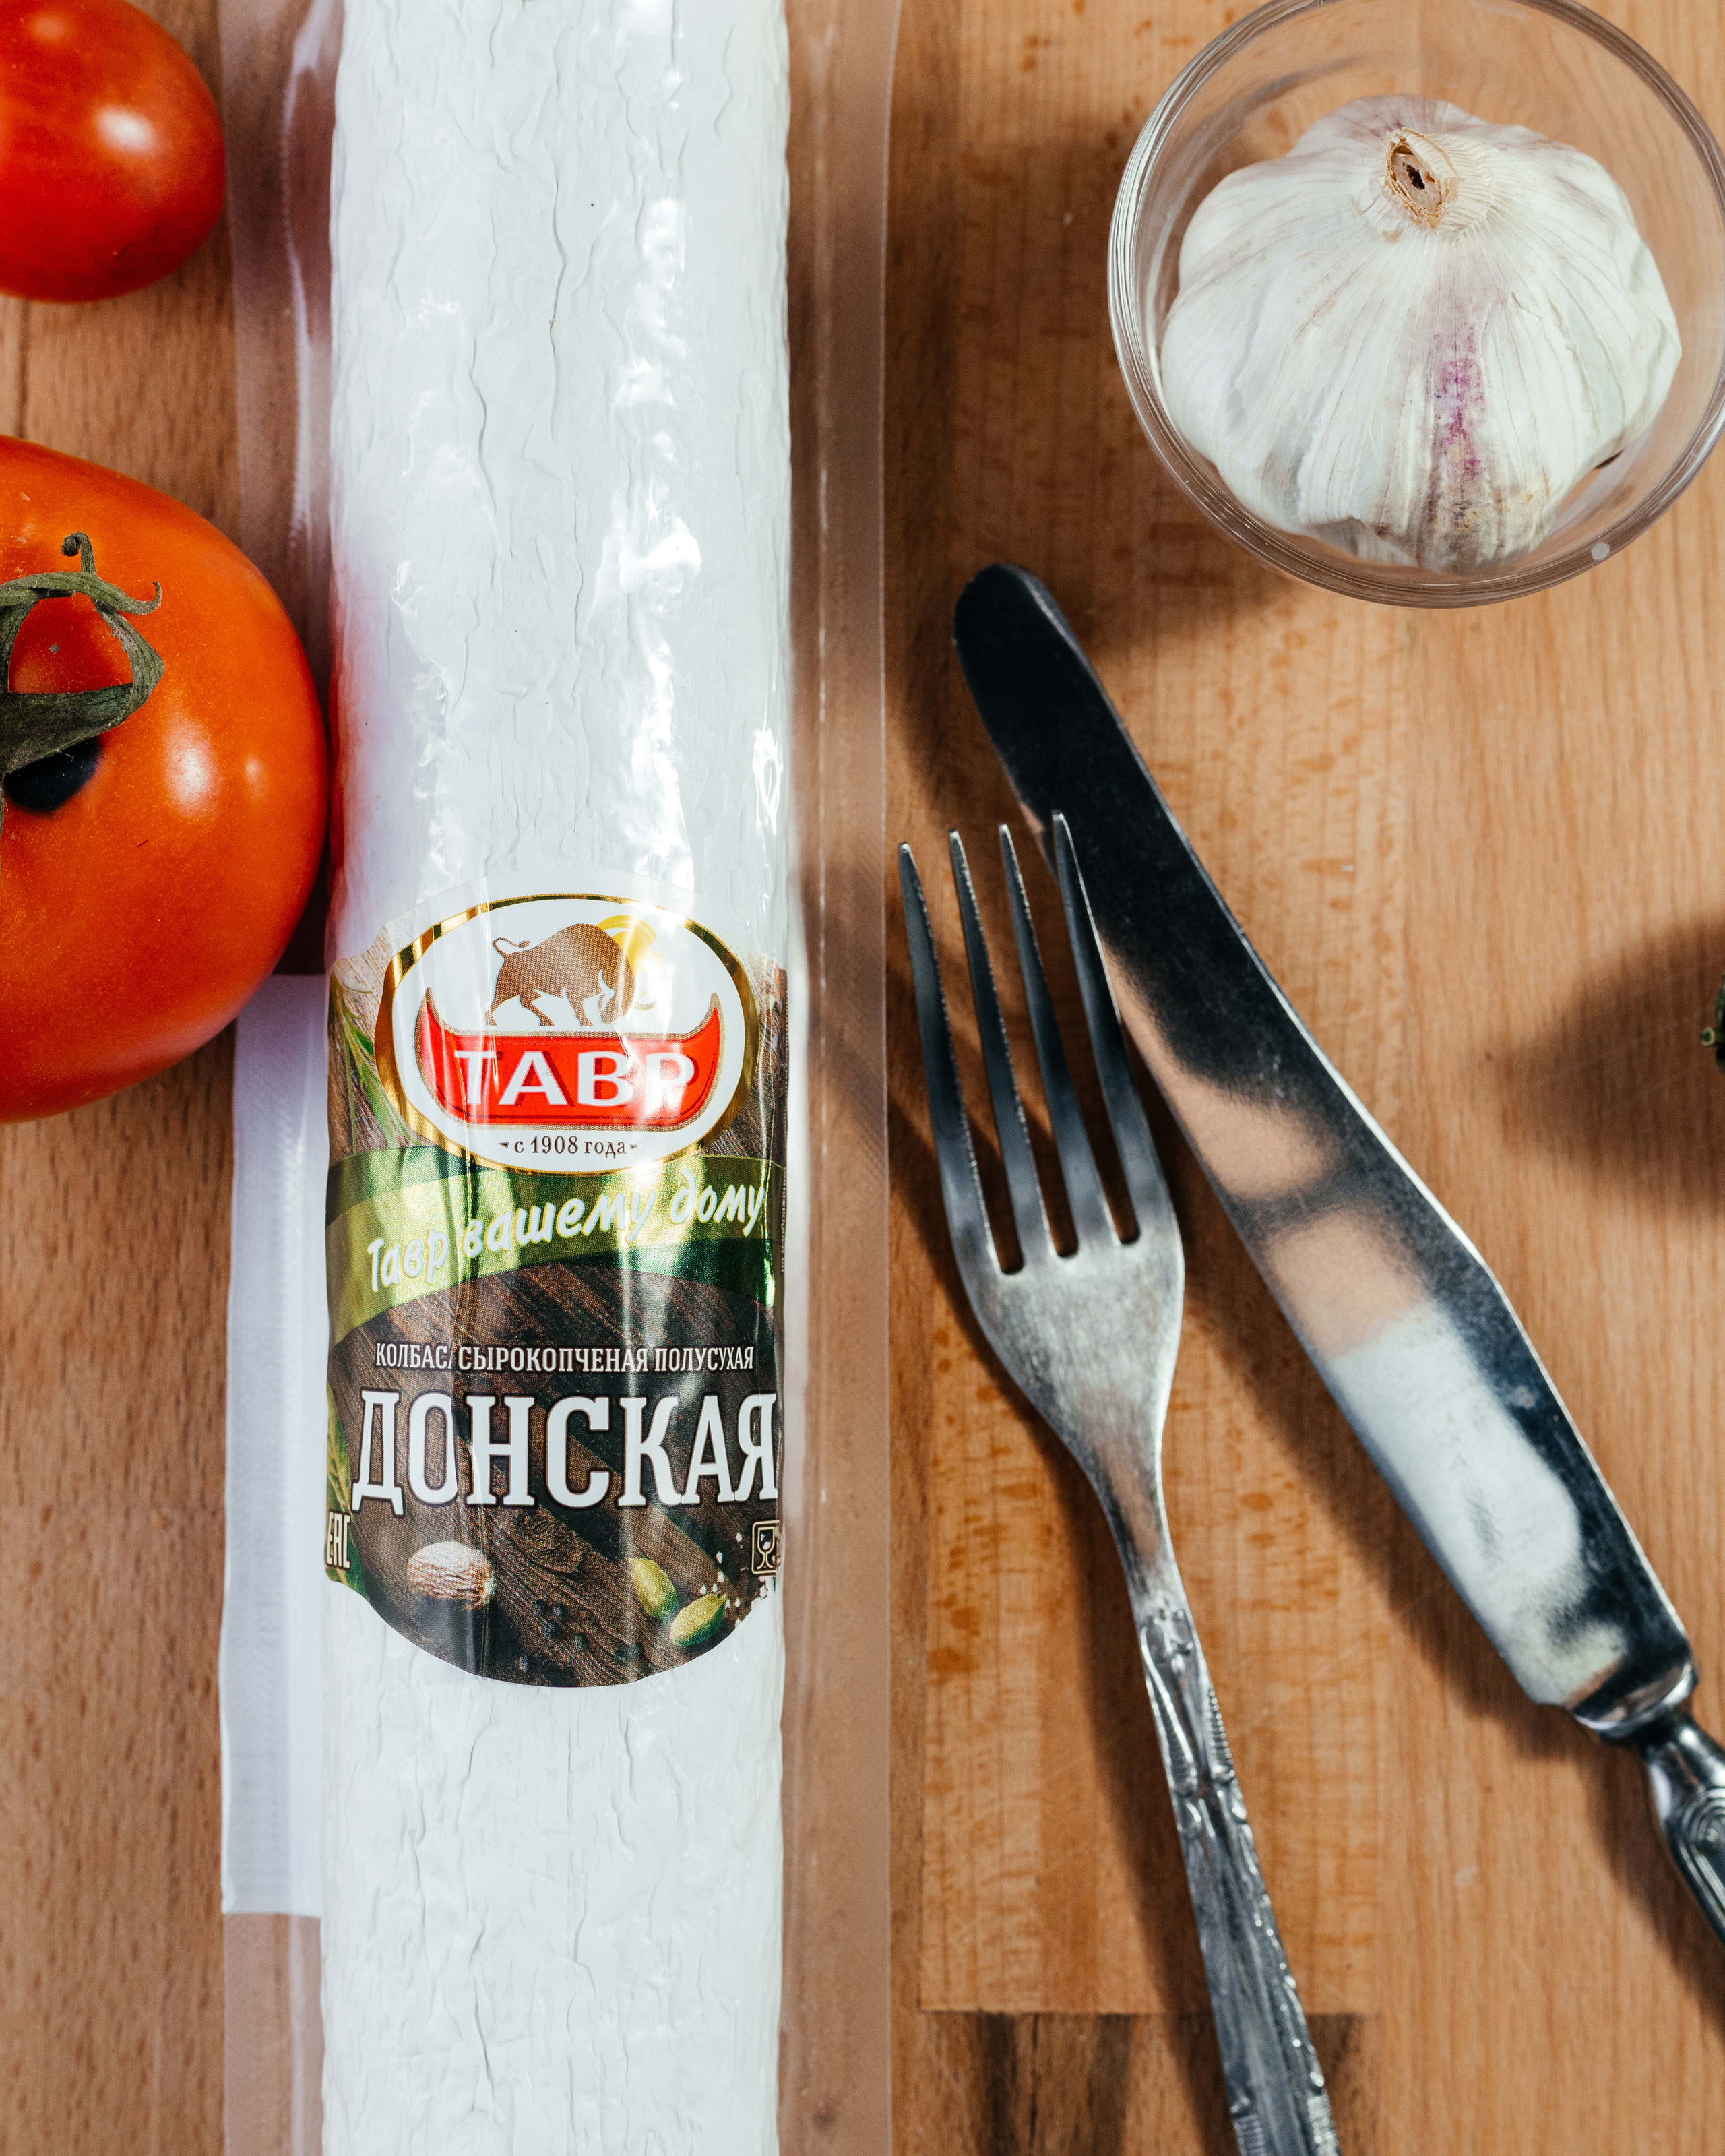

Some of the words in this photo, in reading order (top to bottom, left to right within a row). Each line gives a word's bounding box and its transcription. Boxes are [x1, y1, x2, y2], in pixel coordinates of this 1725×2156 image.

[453, 1051, 695, 1108] ТАВР
[514, 1140, 524, 1153] с
[530, 1135, 578, 1154] 1908
[584, 1141, 626, 1158] года
[368, 1229, 449, 1292] Тавр
[462, 1190, 656, 1258] вашему
[670, 1167, 765, 1236] дому
[458, 1347, 648, 1372] СЫРОКОПЧЕНАЯ
[655, 1347, 754, 1372] ПОЛУСУХАЯ
[352, 1390, 778, 1515] ДОНСКАЯ
